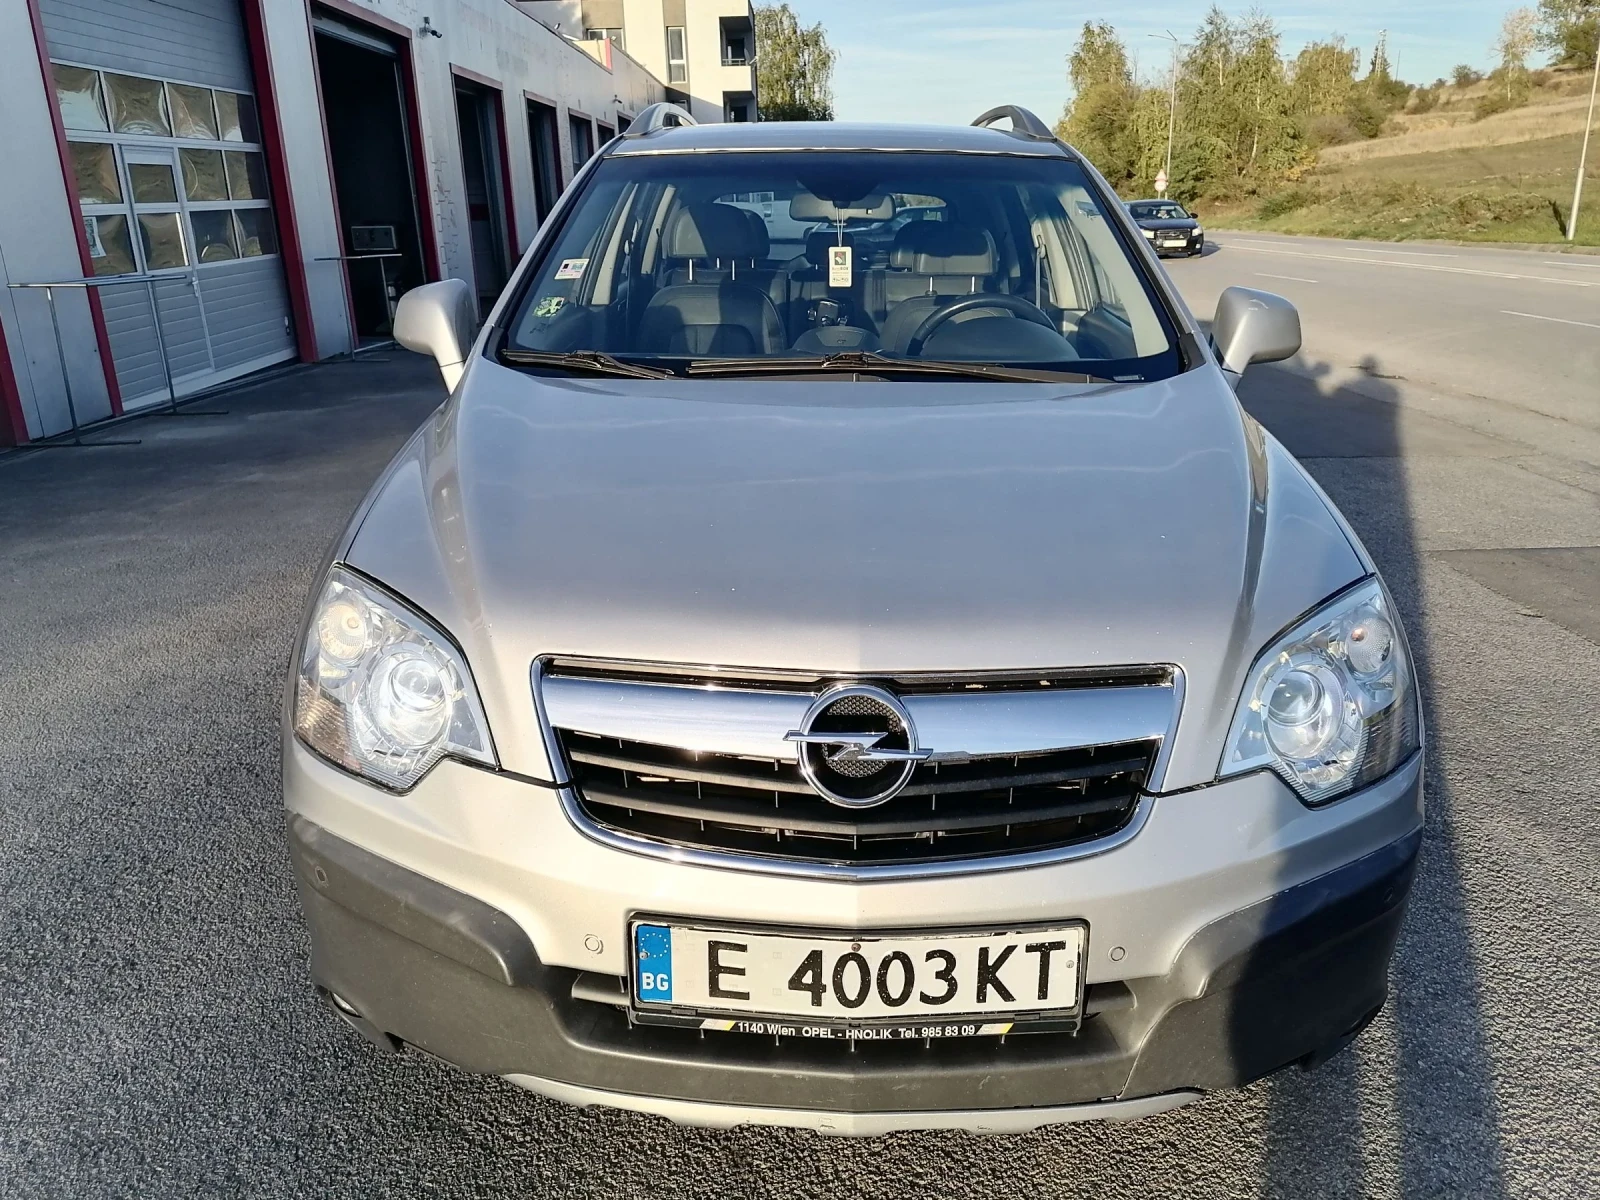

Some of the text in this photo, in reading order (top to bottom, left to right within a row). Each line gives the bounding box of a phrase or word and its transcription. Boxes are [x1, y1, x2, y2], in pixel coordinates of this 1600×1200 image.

[642, 972, 669, 991] BG
[708, 940, 1067, 1009] E 4003 KT
[738, 1021, 764, 1034] 1140
[767, 1023, 796, 1037] Wien
[802, 1026, 835, 1039] OPEL
[845, 1028, 892, 1040] HNOLIK
[898, 1027, 918, 1038] Tel.
[921, 1026, 942, 1037] 985
[945, 1025, 959, 1036] 83
[961, 1024, 976, 1035] 09
